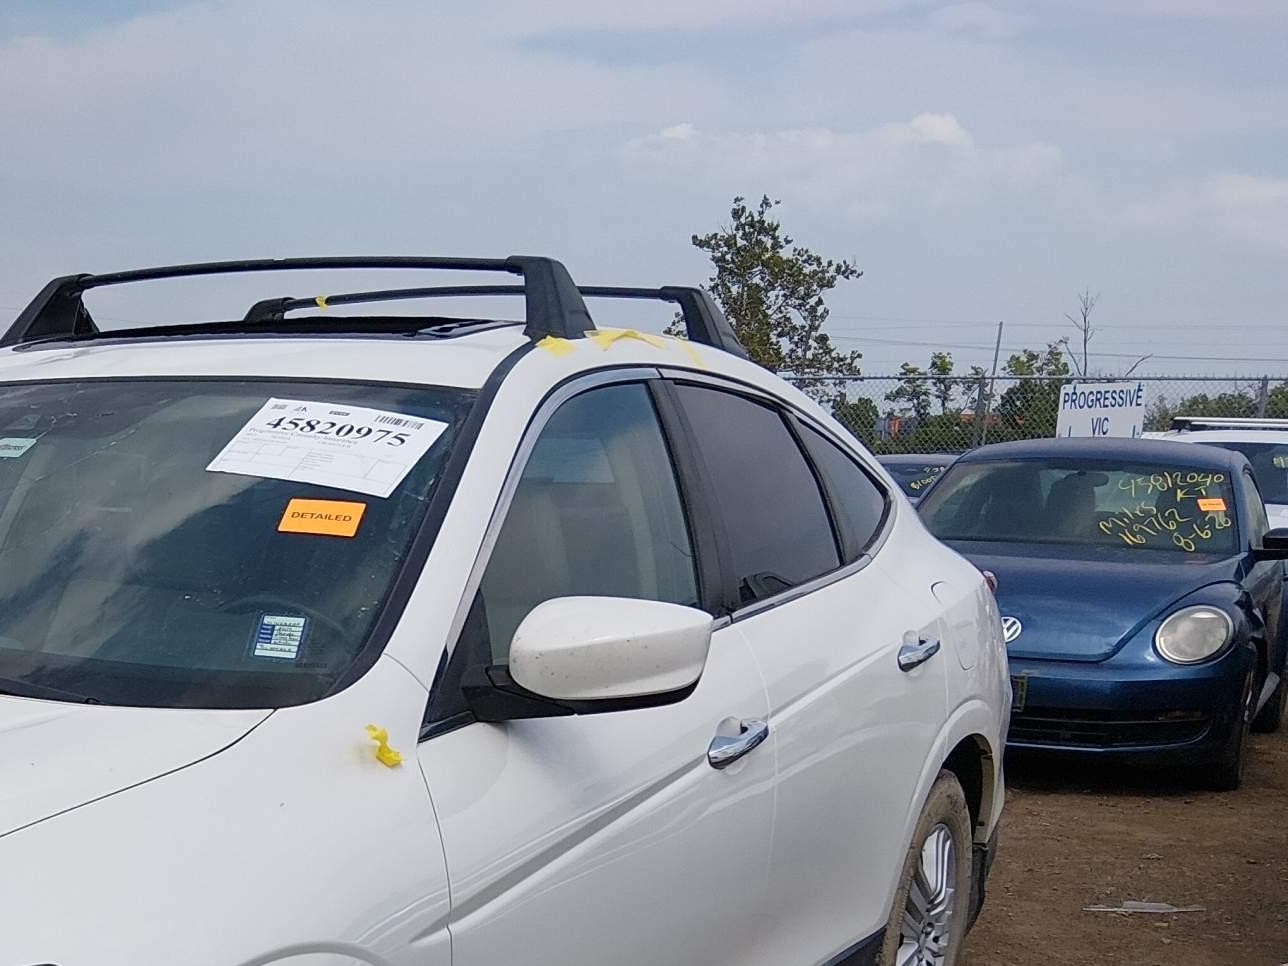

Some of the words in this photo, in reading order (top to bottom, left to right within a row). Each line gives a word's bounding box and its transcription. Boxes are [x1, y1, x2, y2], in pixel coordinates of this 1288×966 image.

[1062, 387, 1144, 410] PROGRESSIVE
[265, 415, 412, 448] 45820975
[1091, 416, 1110, 436] VIC
[1118, 471, 1225, 498] 45812040
[290, 511, 353, 523] DETAILED
